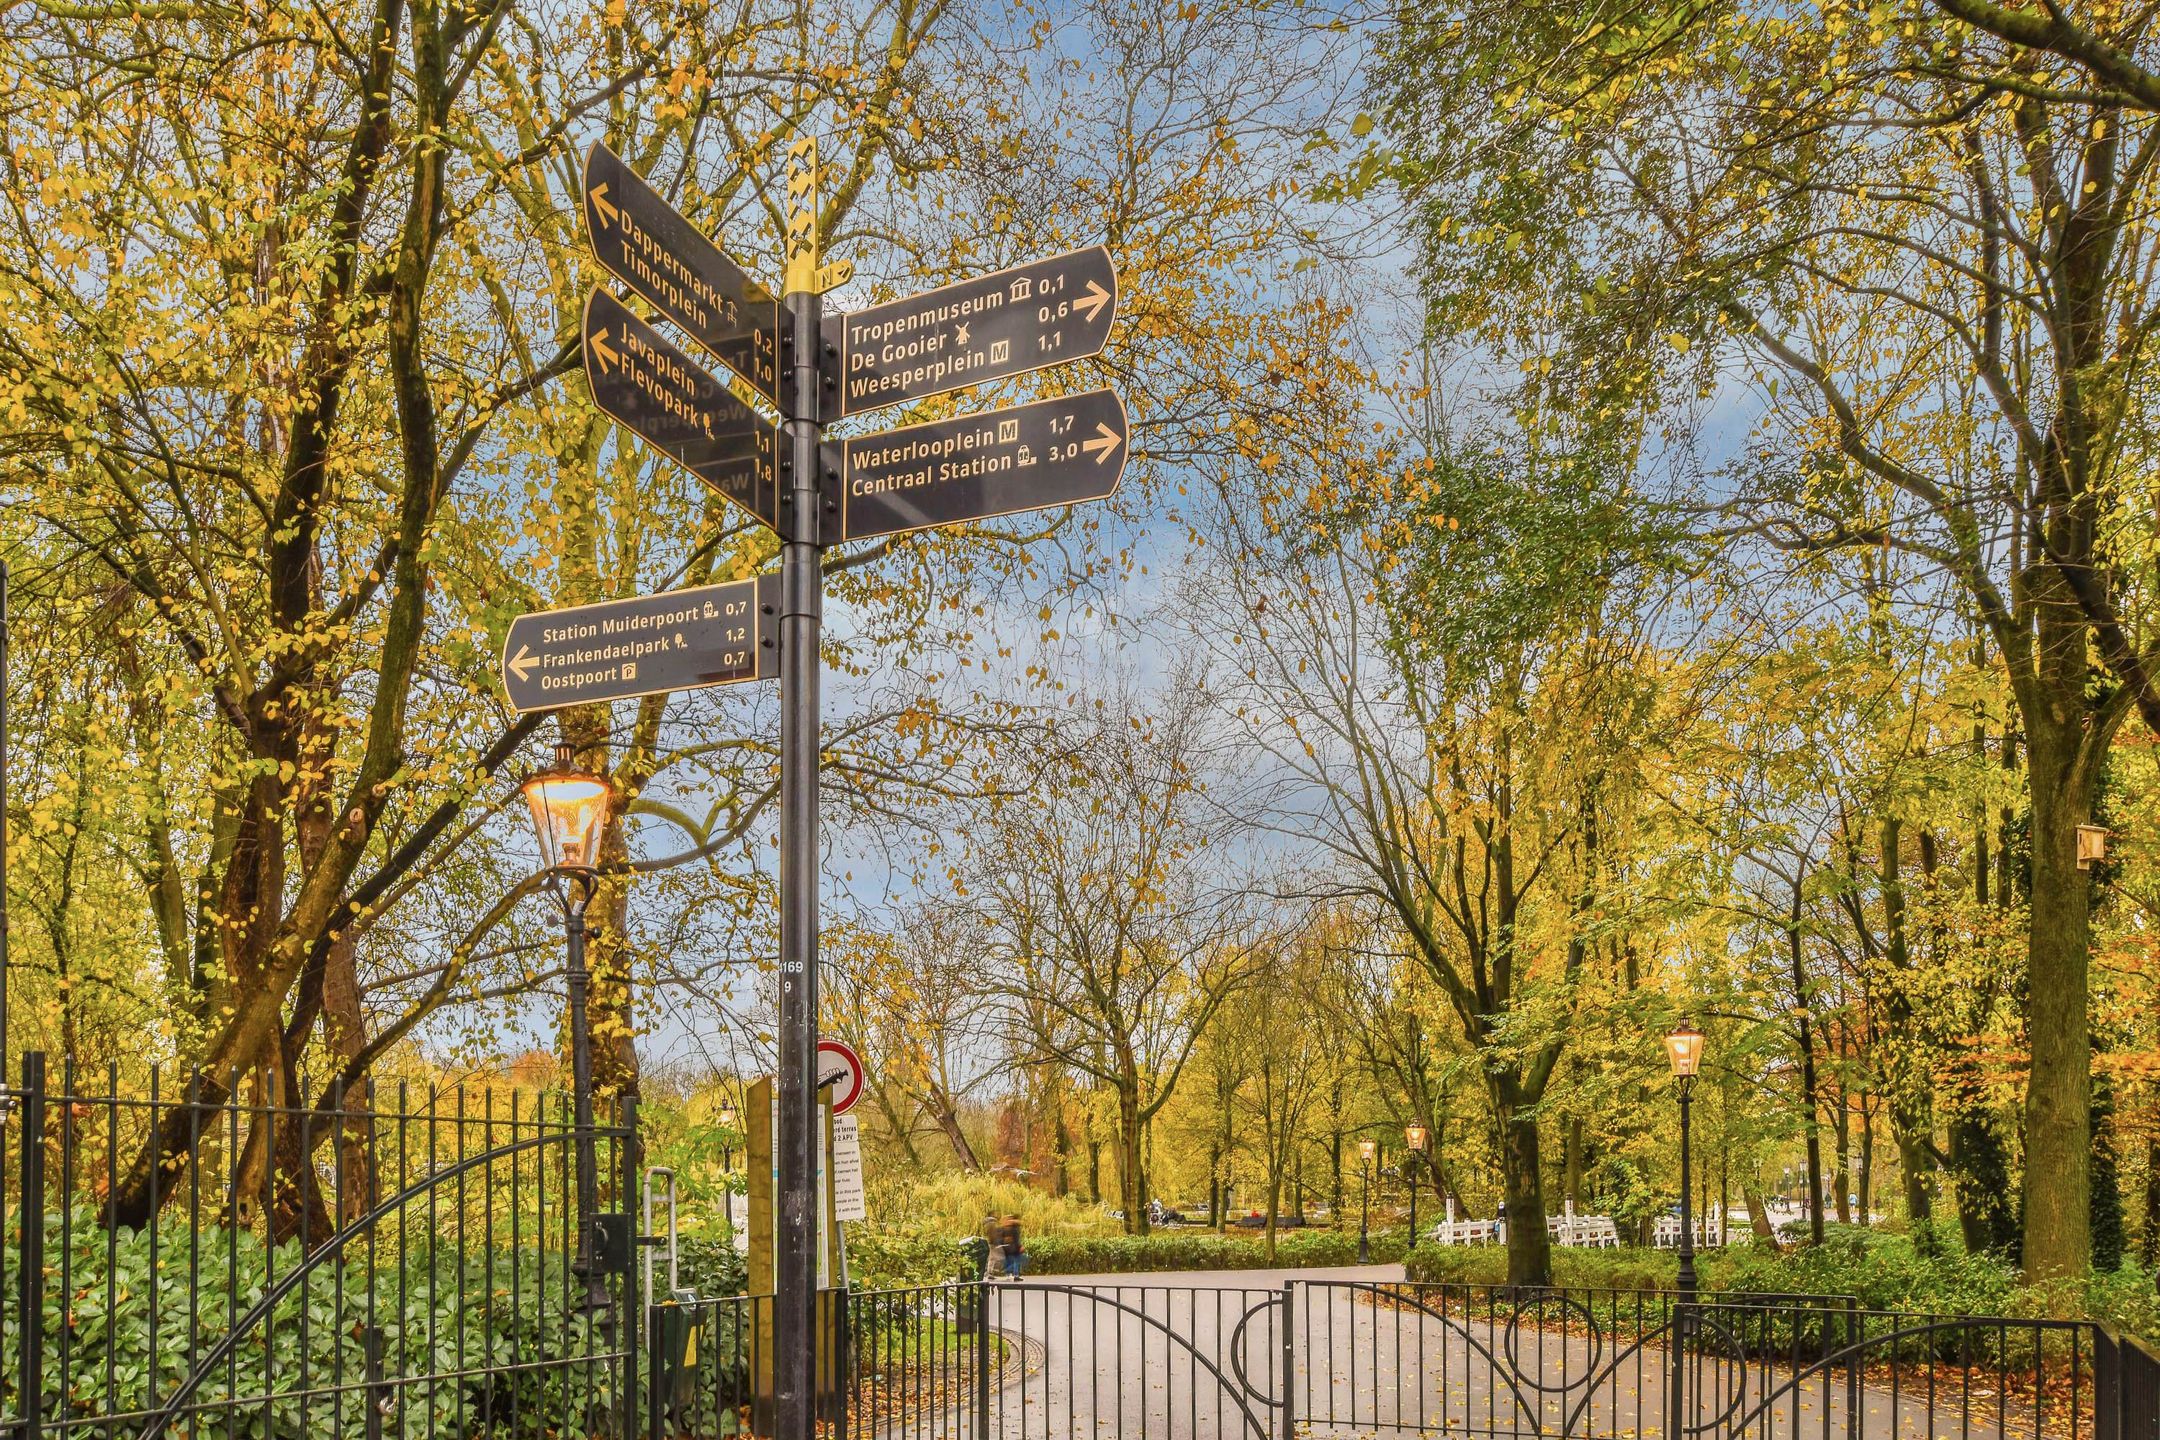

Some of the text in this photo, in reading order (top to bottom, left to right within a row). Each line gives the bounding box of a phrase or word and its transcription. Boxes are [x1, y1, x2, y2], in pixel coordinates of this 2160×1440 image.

[620, 239, 772, 382] Timorplein 1,0
[621, 209, 772, 356] Dappermarkt 0,2
[851, 274, 1065, 345] Tropenmuseum 0,1
[850, 350, 985, 399] Weesperplein
[1038, 331, 1062, 352] 1,1
[851, 301, 1068, 373] De Gooier 0,6
[620, 322, 695, 396] Javaplein
[754, 430, 770, 454] 1,1
[621, 352, 698, 429] Flevopark
[754, 458, 772, 482] 1,8
[852, 428, 994, 471] Waterlooplein
[1049, 415, 1075, 435] 1,7
[852, 443, 1078, 497] Centraal Station 3,0
[543, 601, 747, 643] Station Muiderpoort 0,7
[543, 627, 746, 668] Frankendaelpark 1,2
[541, 667, 617, 689] Oostpoort
[723, 651, 746, 666] 0,7
[784, 981, 792, 993] 9
